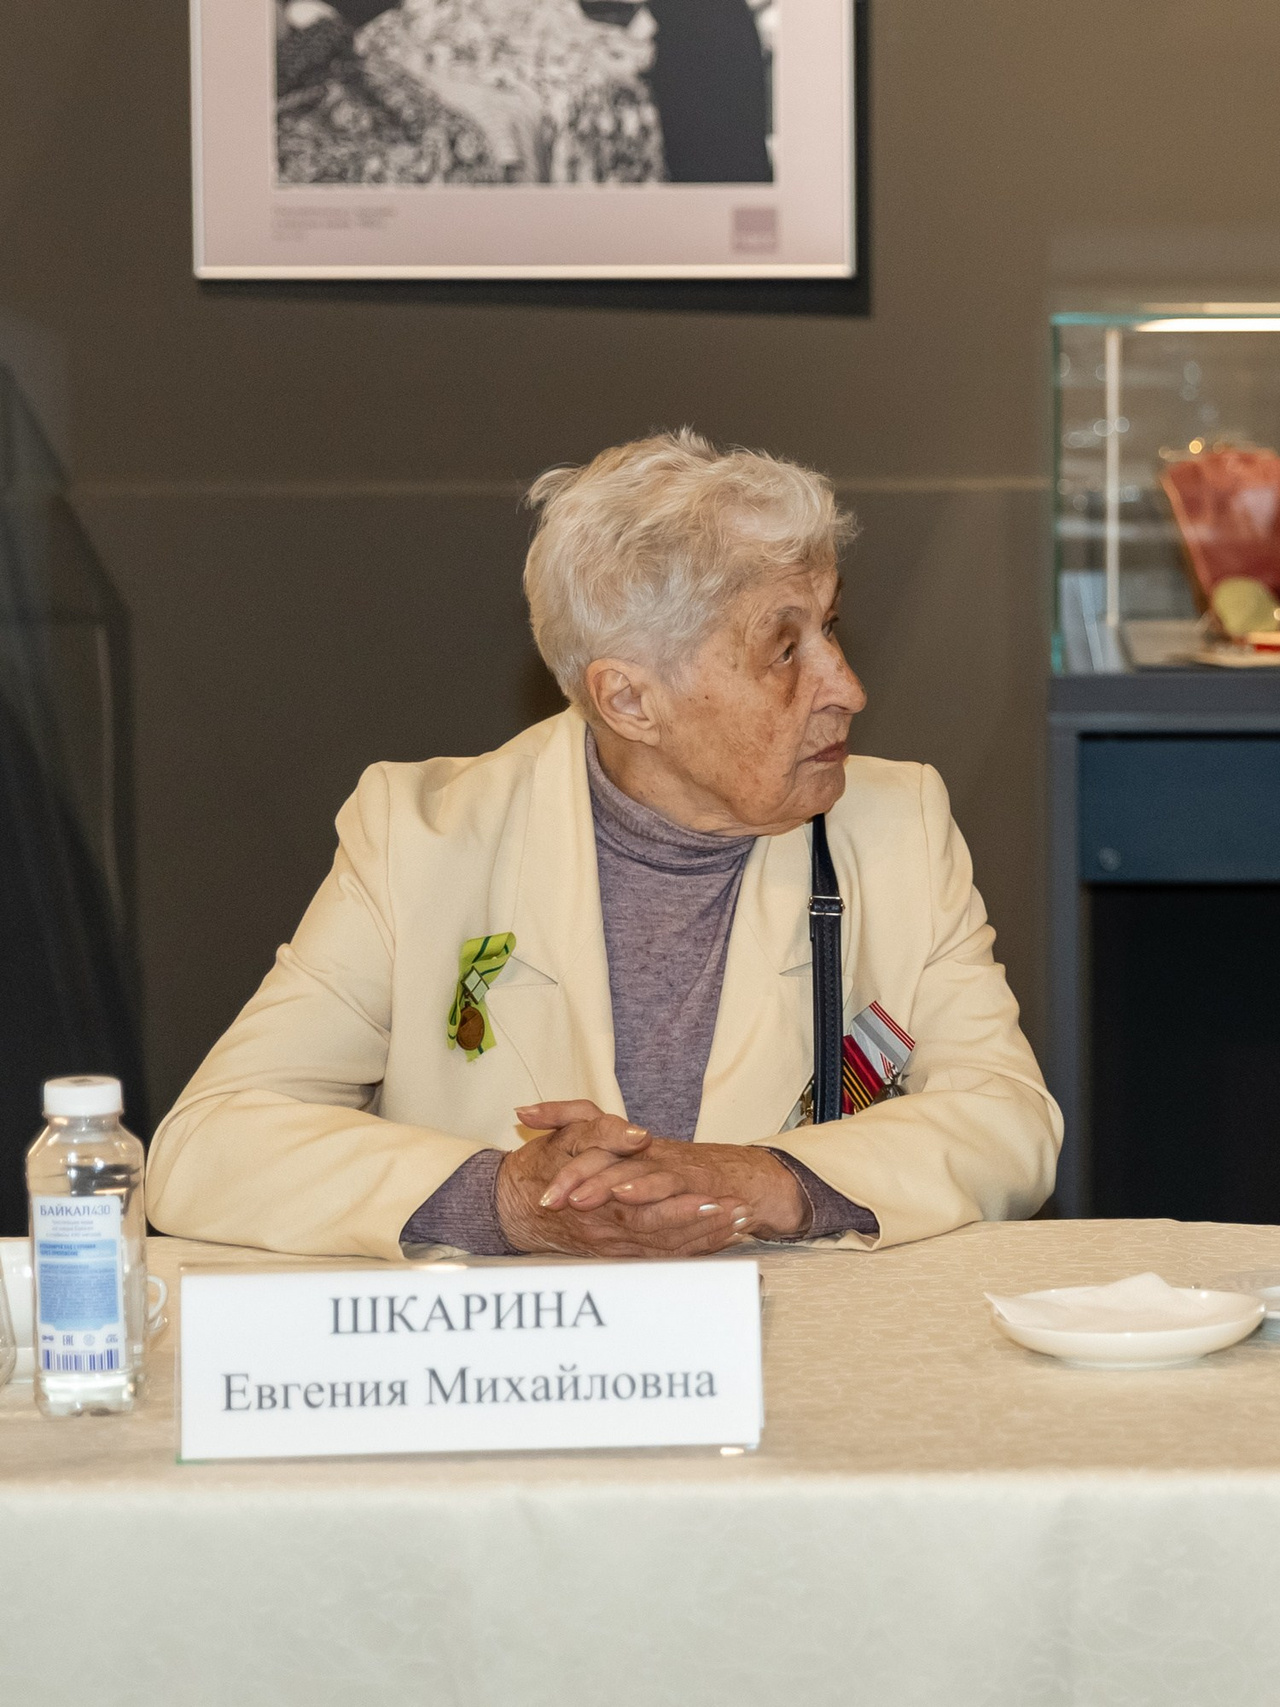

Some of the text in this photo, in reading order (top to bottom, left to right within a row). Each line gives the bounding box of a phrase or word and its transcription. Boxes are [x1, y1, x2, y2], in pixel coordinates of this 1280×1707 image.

[330, 1290, 606, 1335] ШКАРИНА
[222, 1363, 717, 1412] Евгения Михайловна
